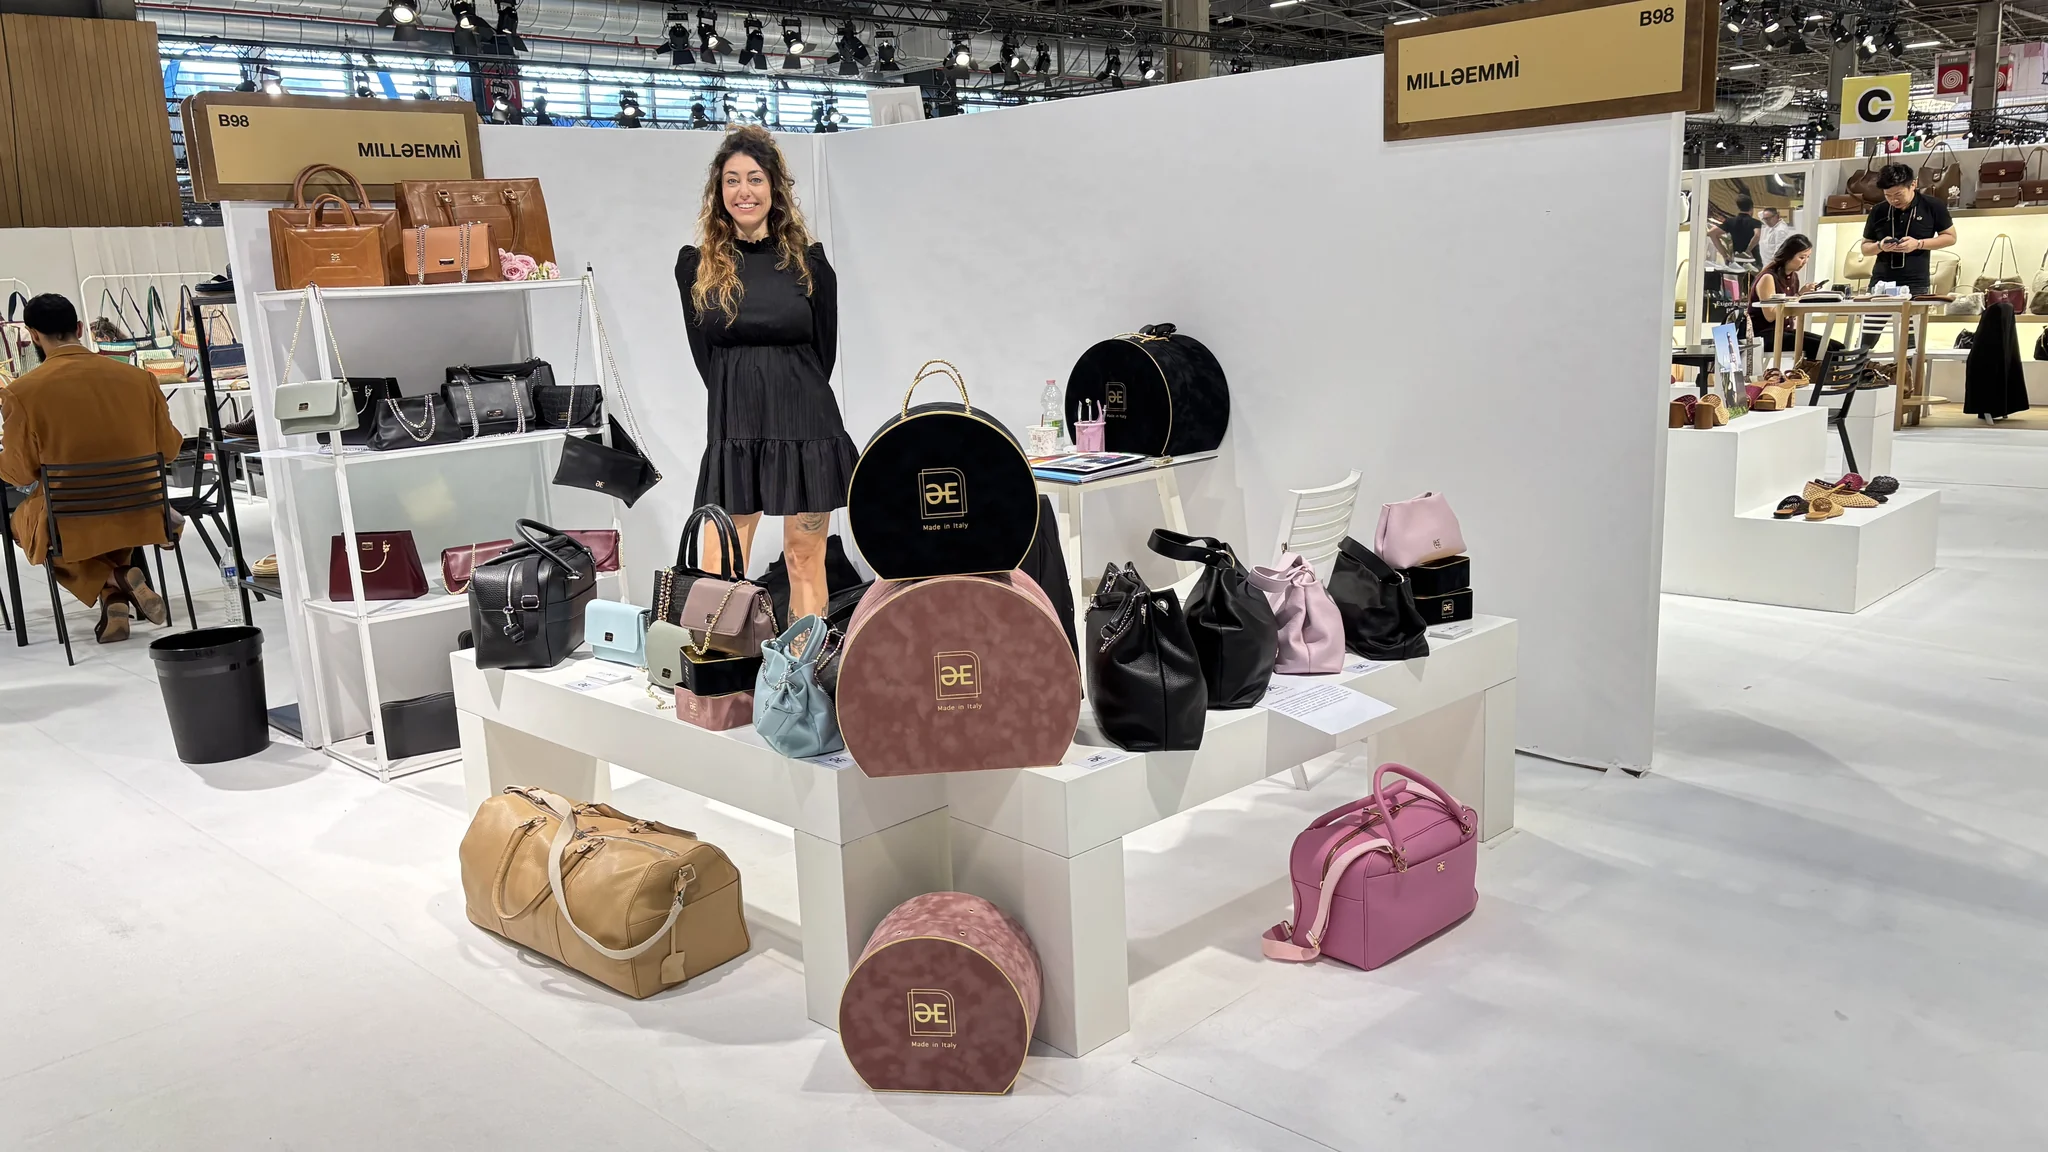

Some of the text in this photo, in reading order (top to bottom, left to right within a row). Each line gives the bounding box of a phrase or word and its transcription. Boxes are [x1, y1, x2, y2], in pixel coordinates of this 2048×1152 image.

[1640, 7, 1675, 27] B98
[1858, 89, 1892, 123] C
[218, 113, 250, 128] B98
[953, 522, 969, 530] Italy
[937, 704, 955, 712] Made
[966, 702, 983, 710] Italy
[911, 1040, 930, 1048] Made
[941, 1041, 957, 1050] Italy
